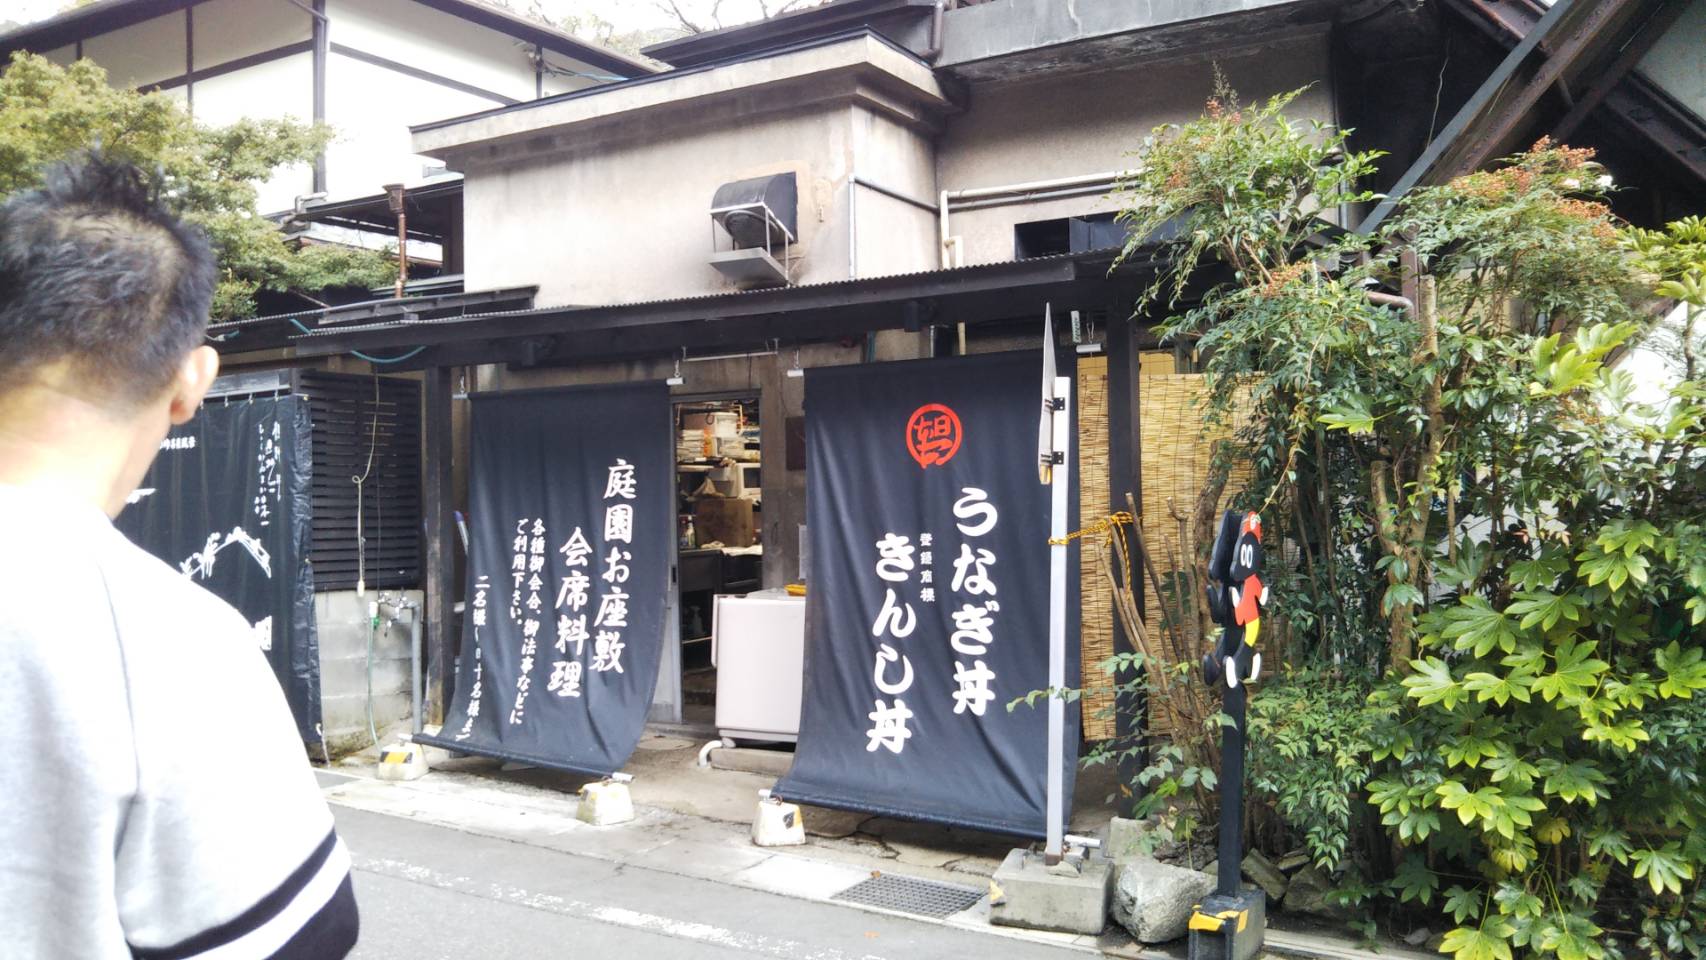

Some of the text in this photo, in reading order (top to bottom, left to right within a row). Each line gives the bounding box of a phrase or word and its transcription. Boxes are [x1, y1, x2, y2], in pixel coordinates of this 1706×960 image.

[547, 526, 593, 698] 会席料理
[588, 458, 637, 674] 庭園お座敷
[865, 532, 917, 754] きんし丼
[950, 487, 1001, 716] うなぎ丼
